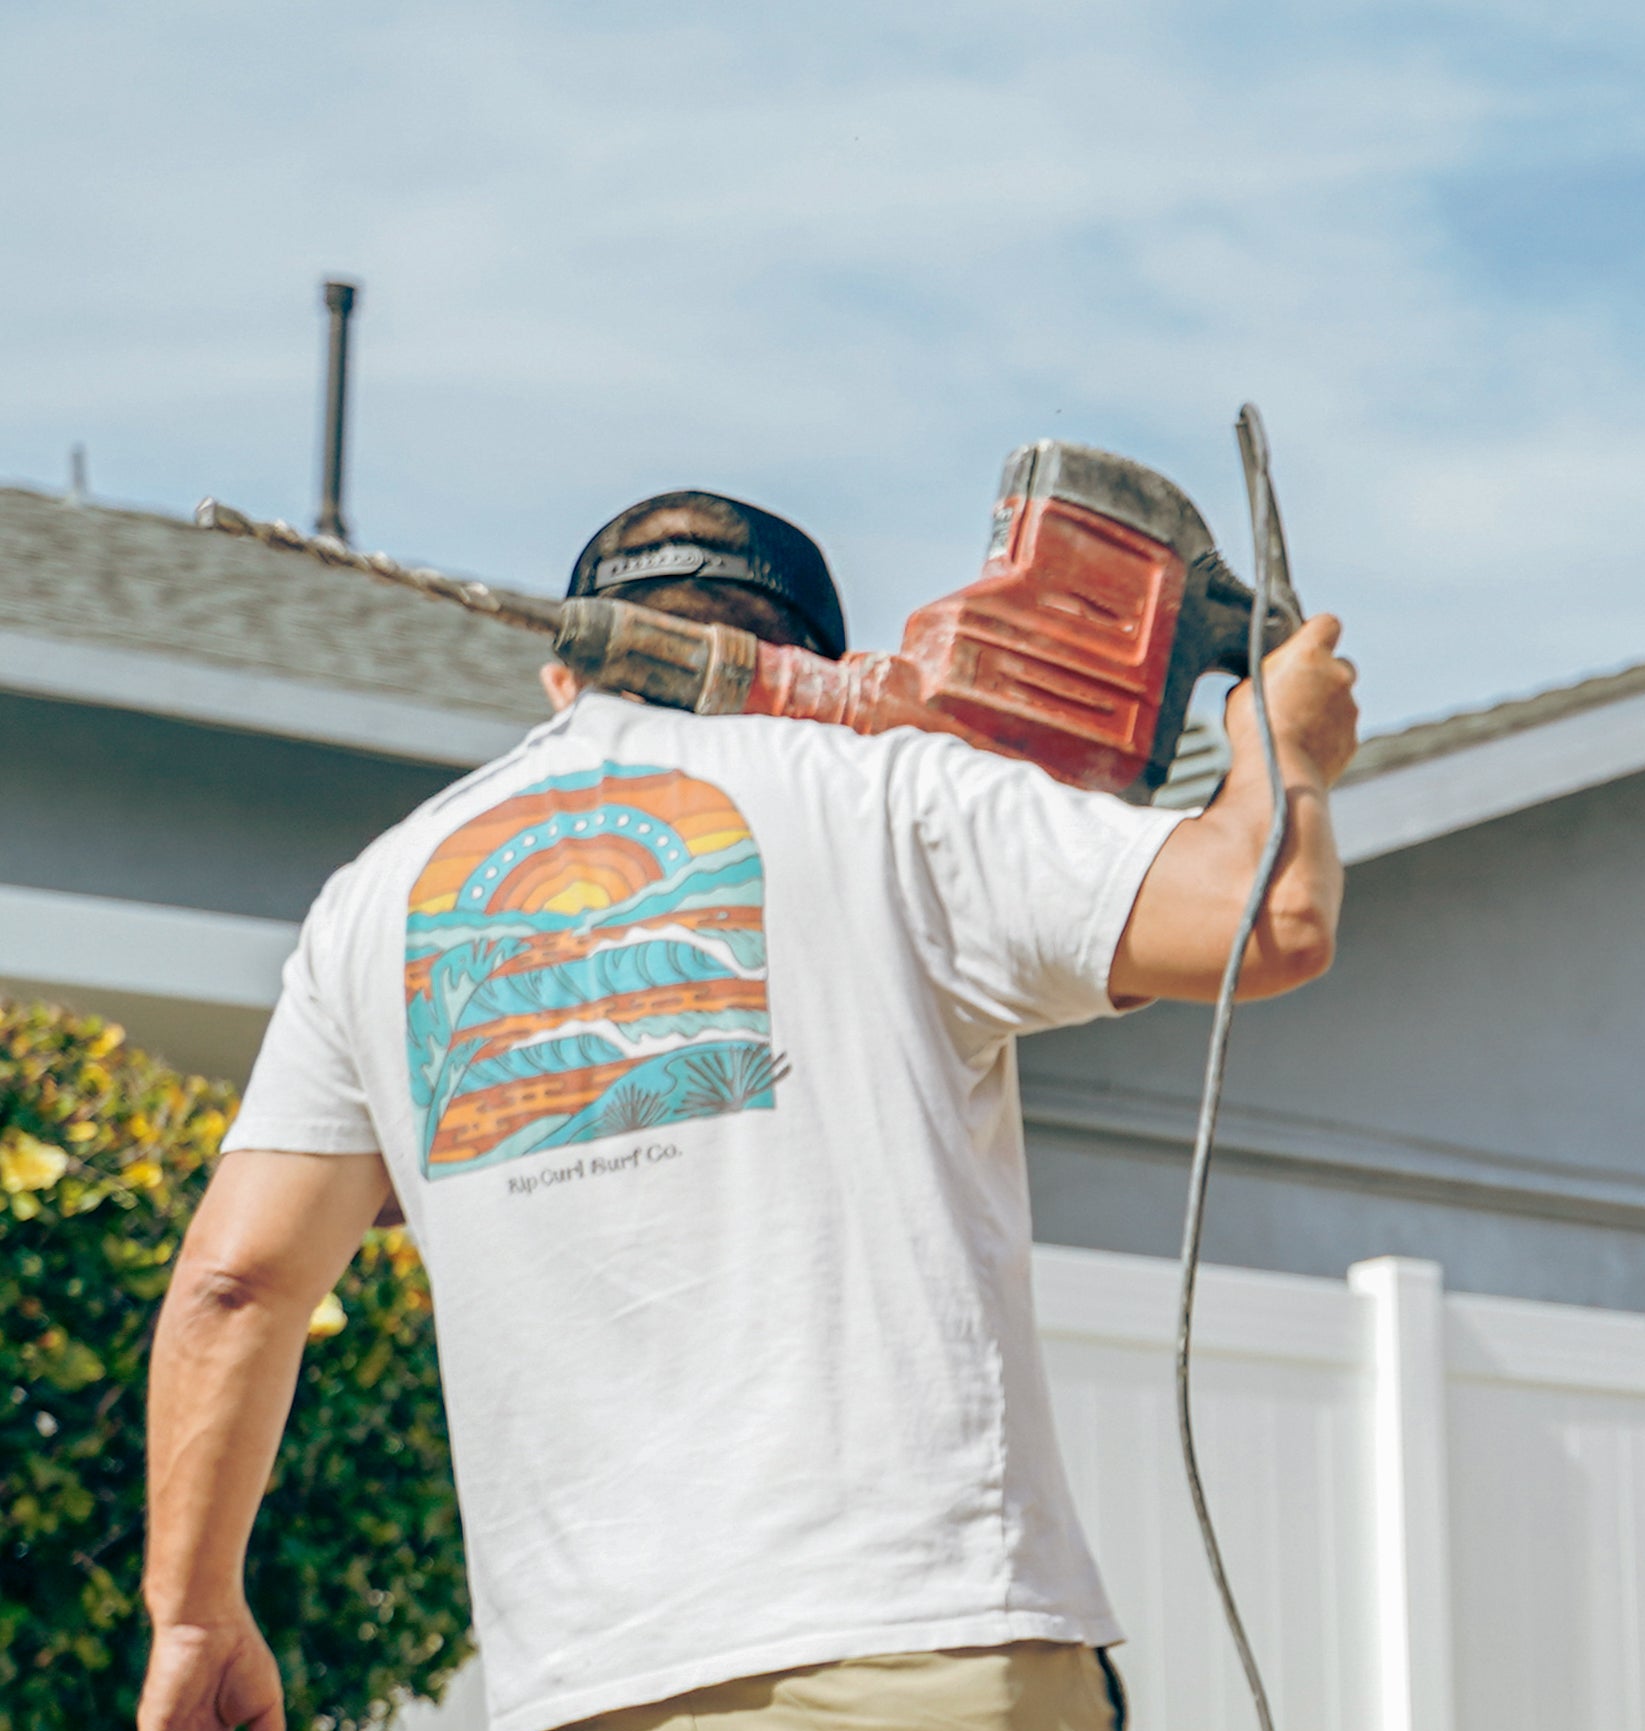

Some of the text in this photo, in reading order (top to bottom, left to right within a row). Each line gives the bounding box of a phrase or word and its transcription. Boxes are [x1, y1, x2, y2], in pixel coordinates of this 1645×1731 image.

[508, 1173, 538, 1195] Rip
[540, 1159, 585, 1187] Curl
[646, 1142, 683, 1162] Co.
